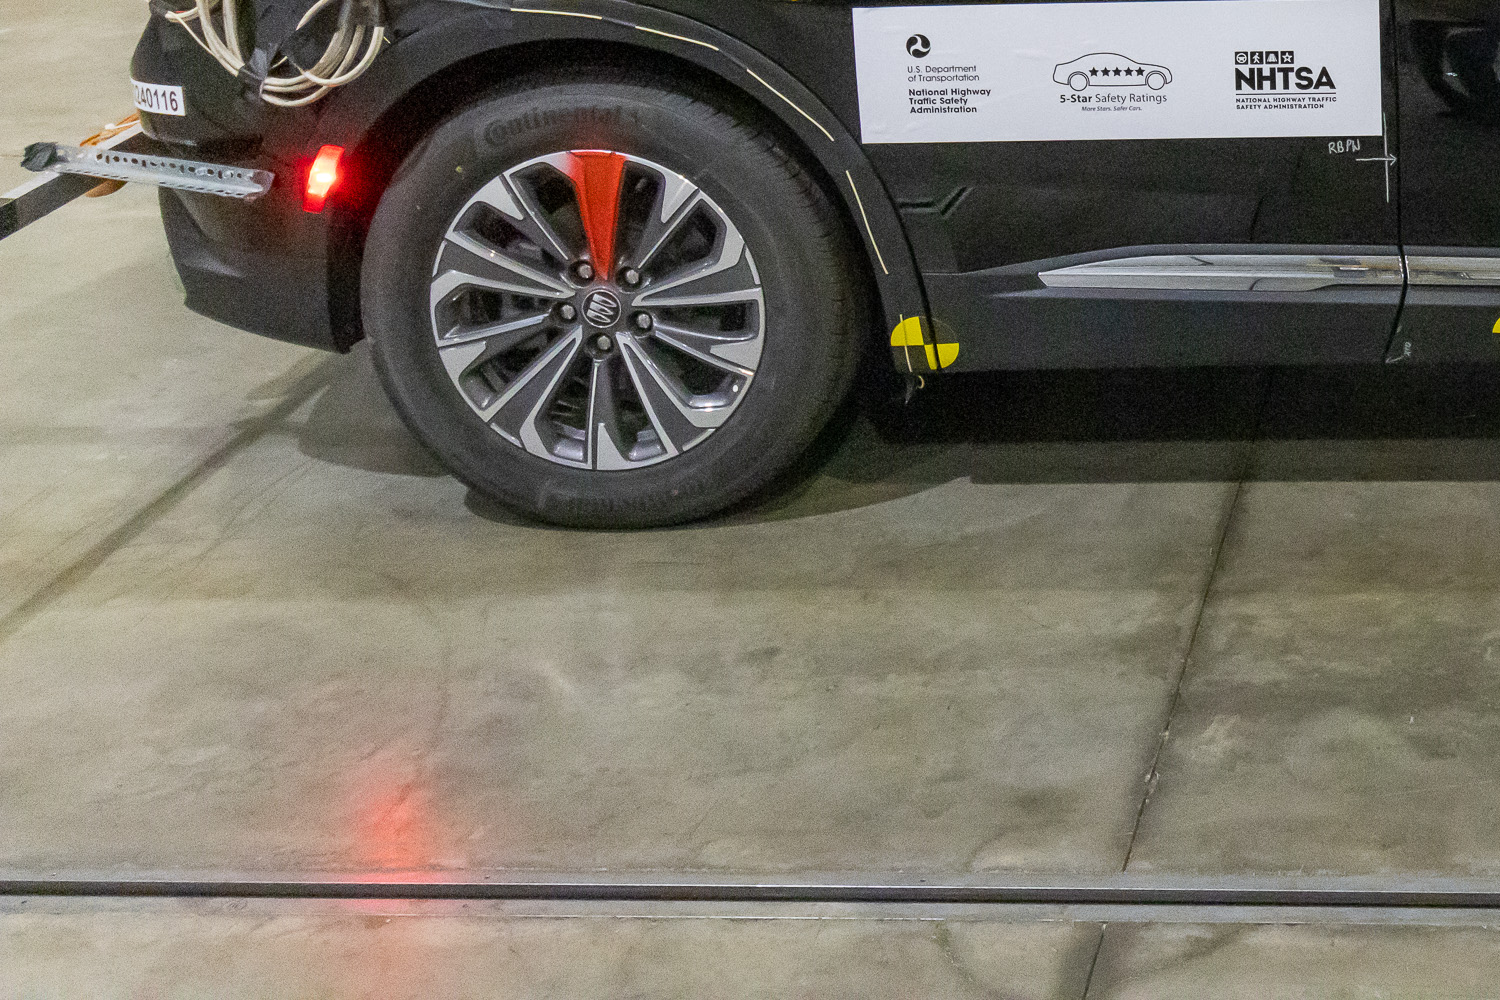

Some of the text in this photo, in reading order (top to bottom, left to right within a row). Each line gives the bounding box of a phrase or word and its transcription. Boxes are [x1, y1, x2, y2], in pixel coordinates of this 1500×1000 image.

[907, 65, 977, 75] U.S. Department
[907, 74, 980, 83] of Transportation
[1235, 66, 1336, 91] NHTSA
[908, 87, 991, 98] National Highway
[908, 97, 968, 106] Traffic Safety
[1060, 92, 1168, 105] 5-Star Safety Ratings
[909, 105, 978, 114] Administration
